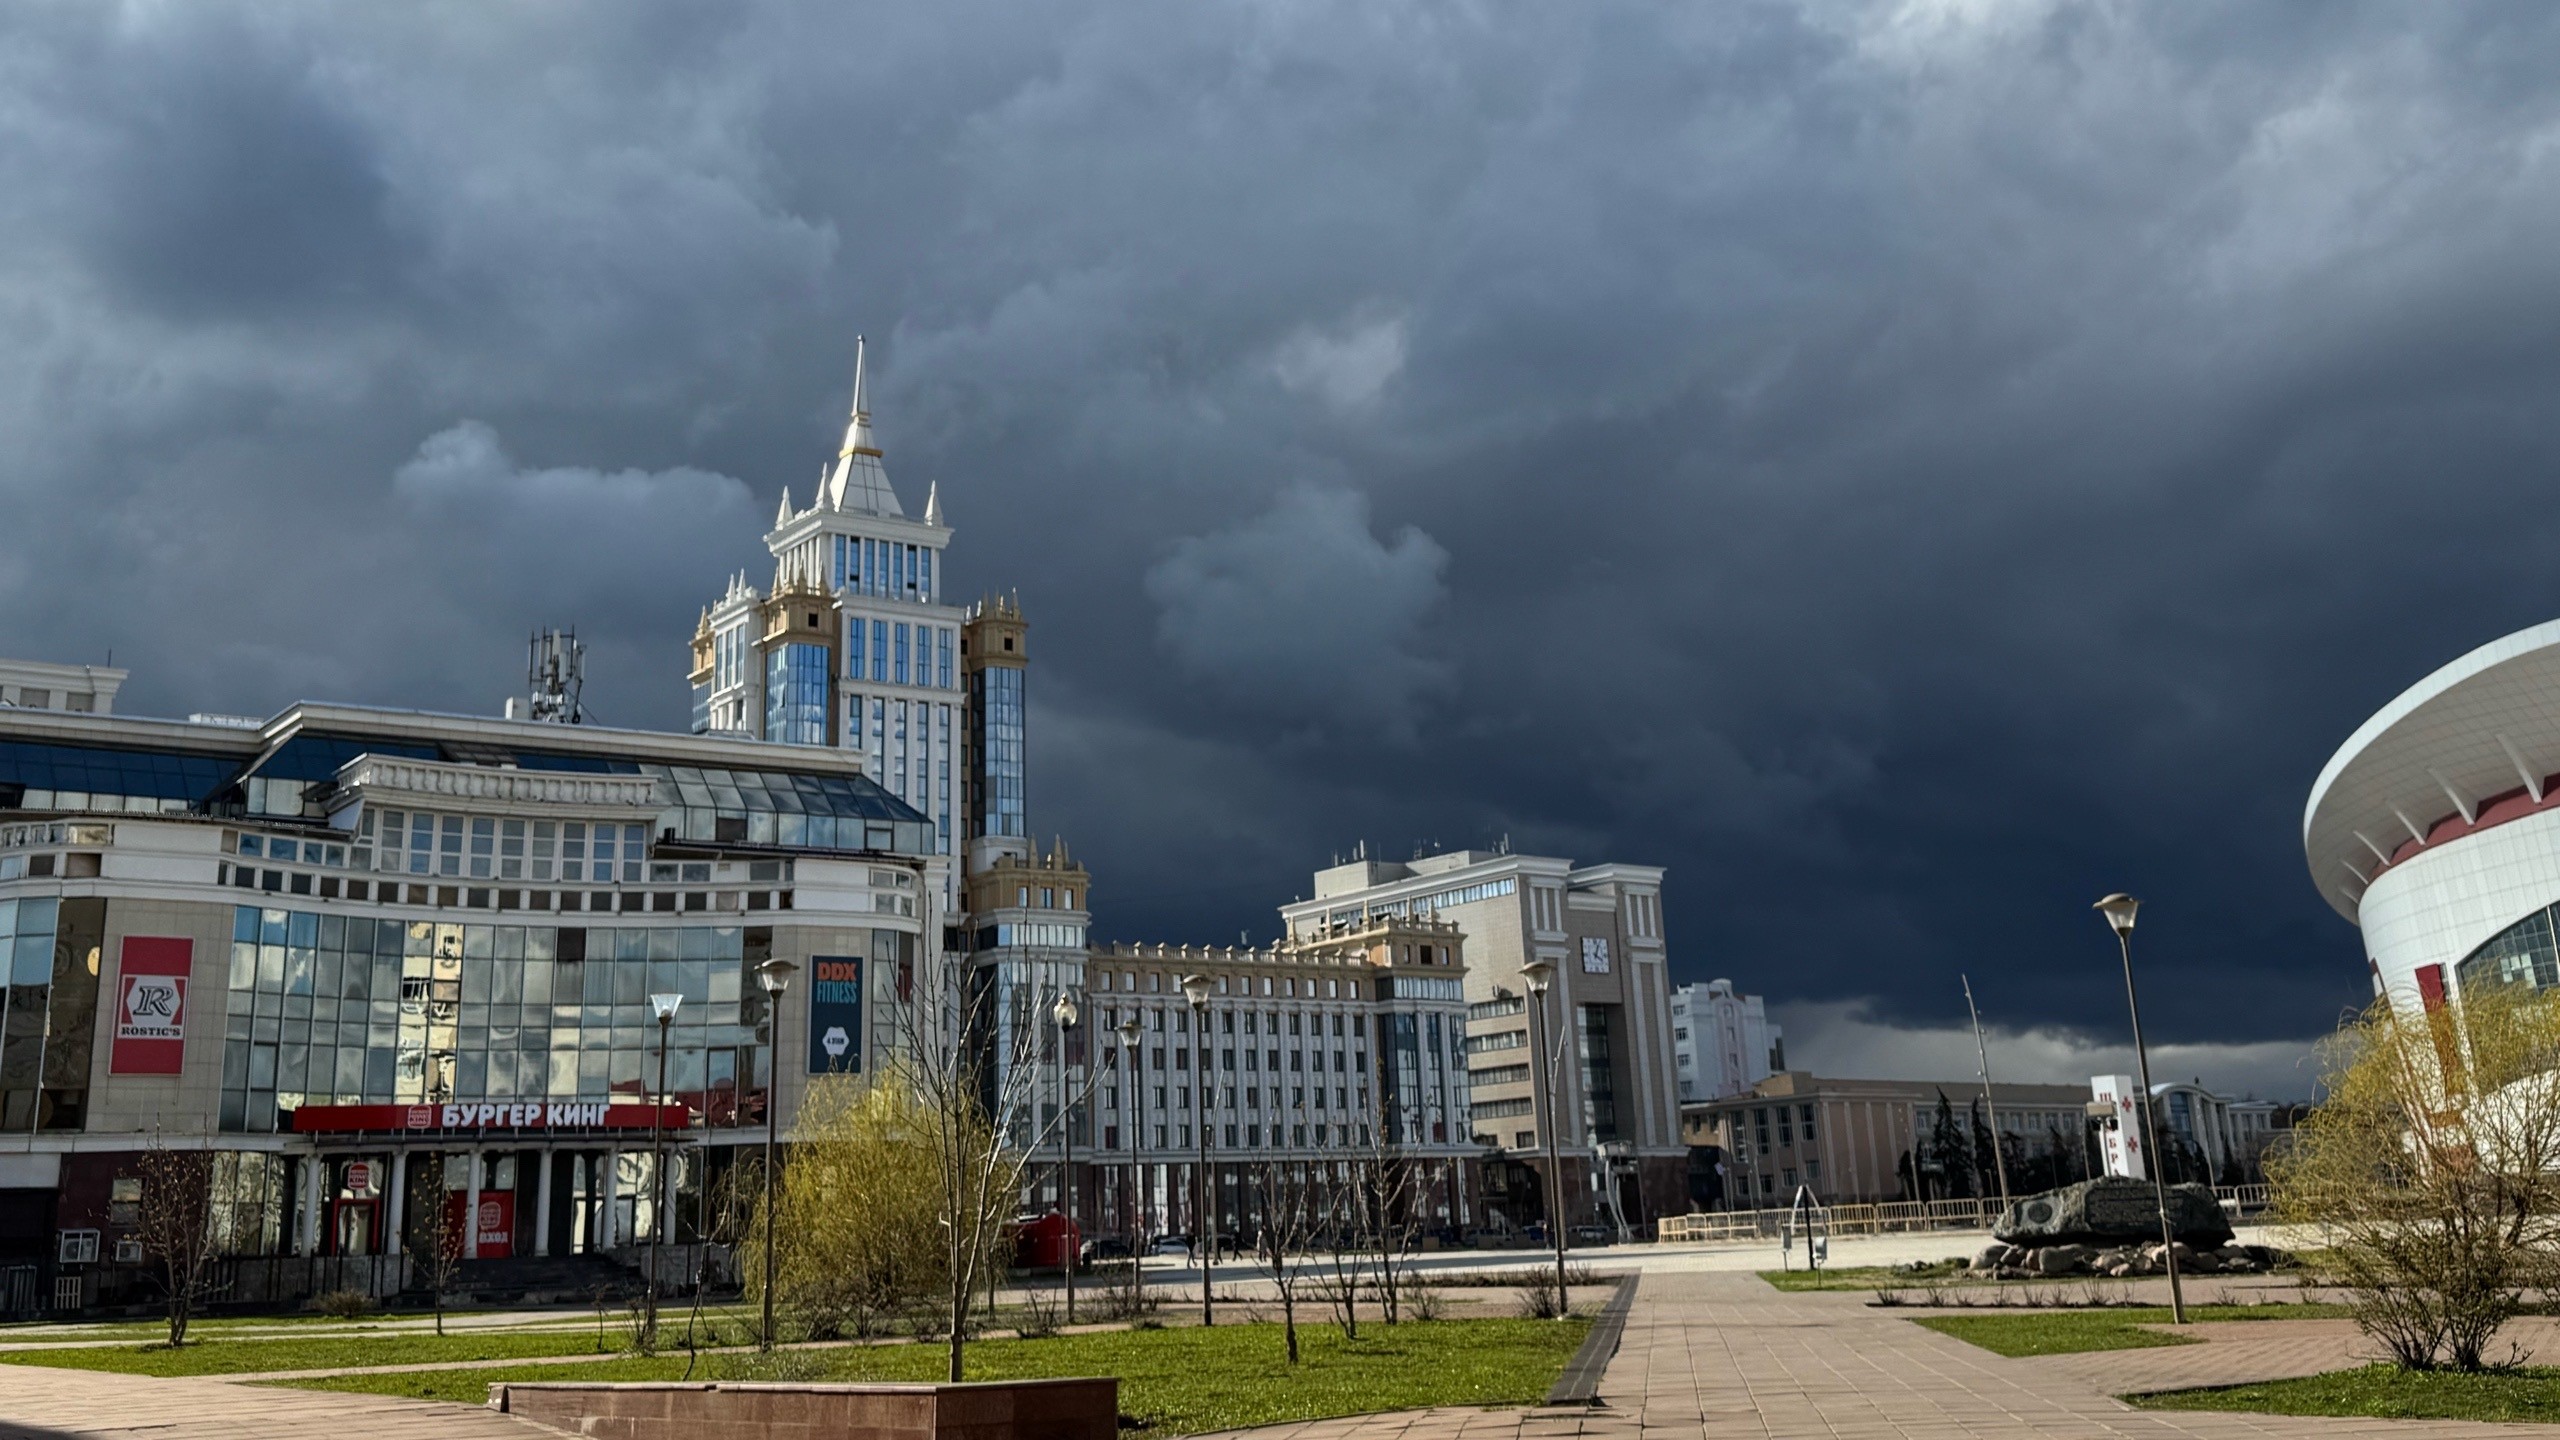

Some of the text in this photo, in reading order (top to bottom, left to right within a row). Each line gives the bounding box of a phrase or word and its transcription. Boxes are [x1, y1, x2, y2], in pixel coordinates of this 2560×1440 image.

[817, 962, 857, 981] DDX
[132, 985, 174, 1016] R
[816, 981, 857, 1004] FITNESS
[121, 1026, 181, 1036] ROSTIC'S
[442, 1104, 610, 1127] БУРГЕР КИНГ
